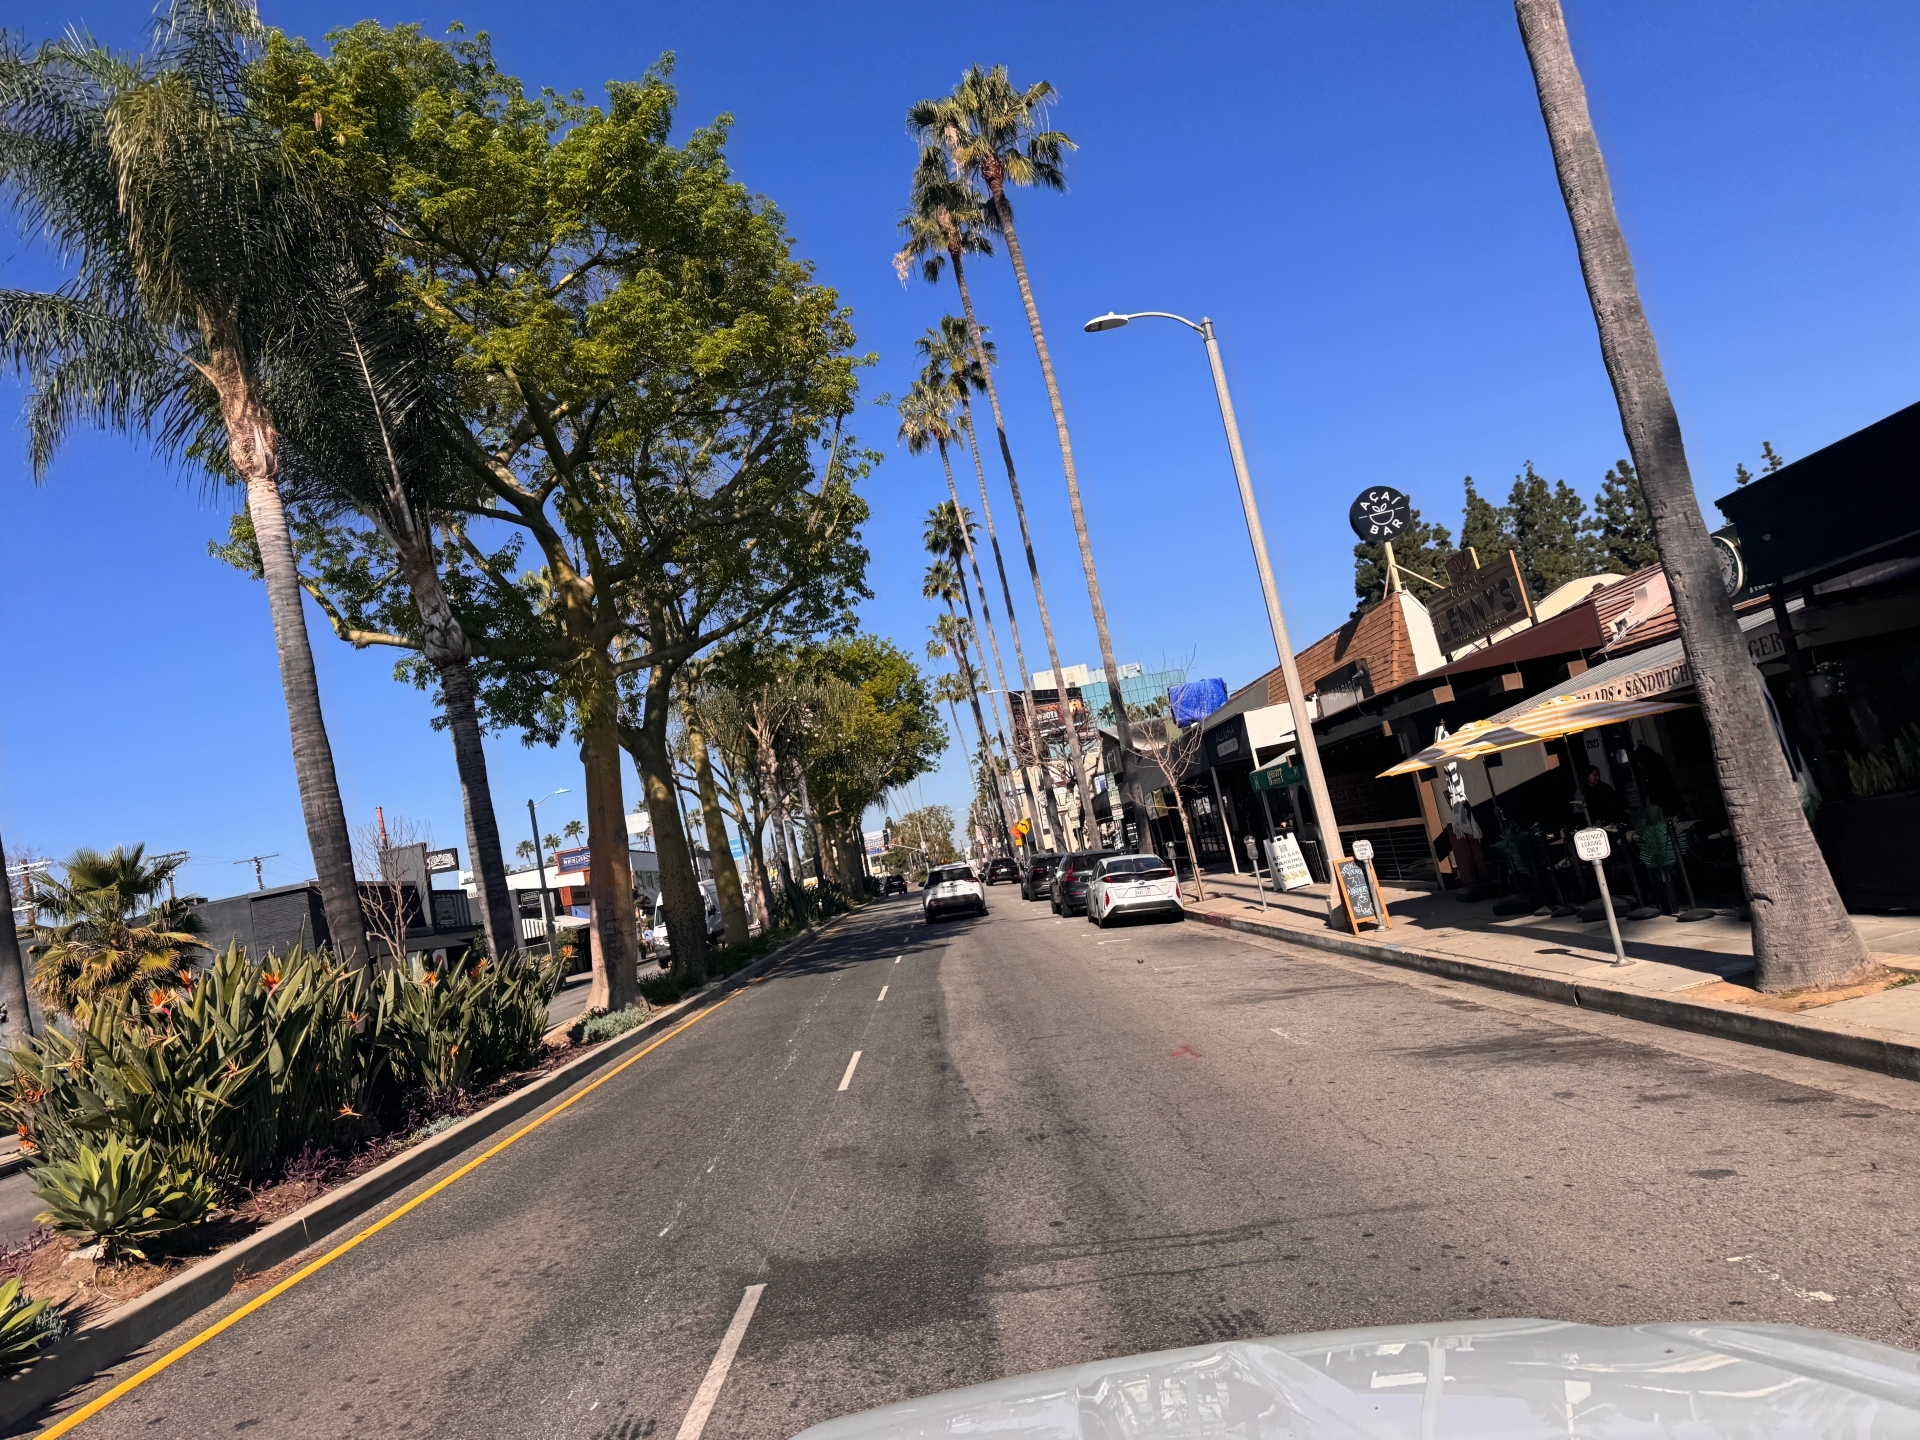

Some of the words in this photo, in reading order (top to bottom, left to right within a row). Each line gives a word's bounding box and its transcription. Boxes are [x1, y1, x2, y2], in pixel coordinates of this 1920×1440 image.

[1369, 518, 1403, 536] BAR
[1435, 577, 1517, 643] LENNY'S
[1577, 833, 1603, 841] PASSENGER
[1274, 857, 1302, 867] PARKING
[1286, 862, 1304, 870] REAR
